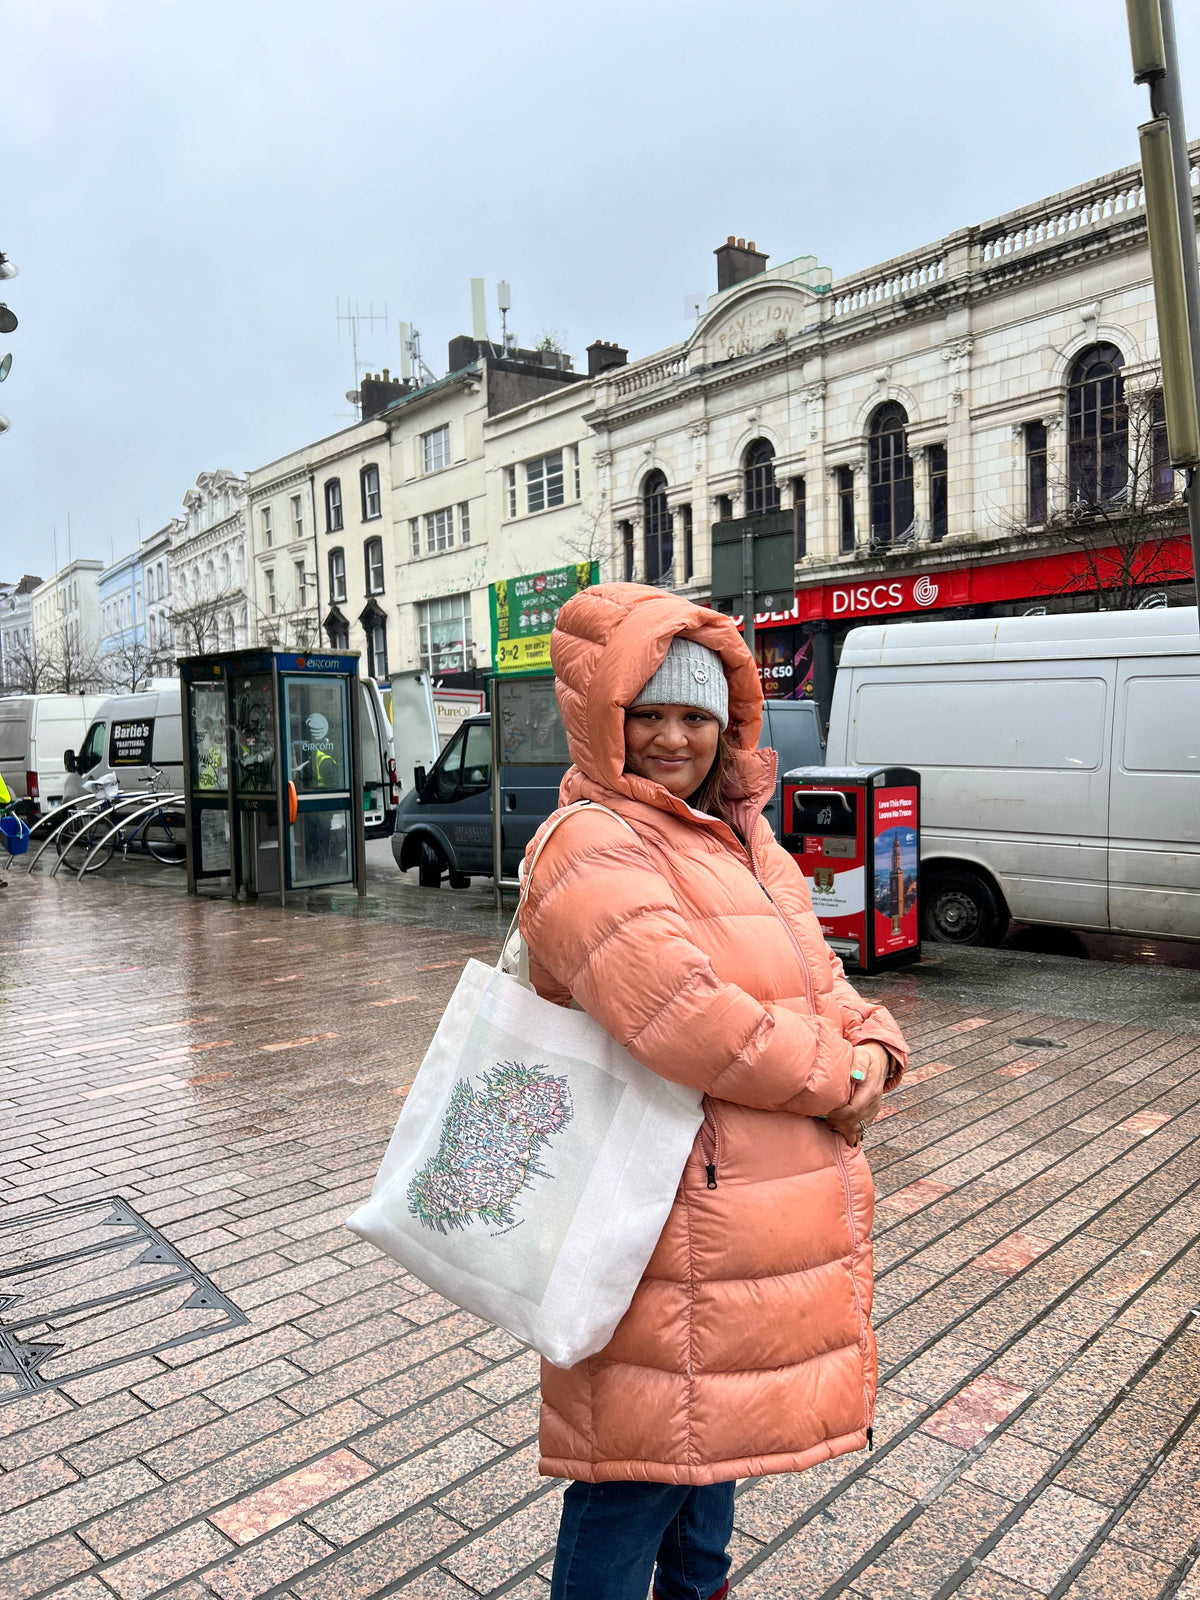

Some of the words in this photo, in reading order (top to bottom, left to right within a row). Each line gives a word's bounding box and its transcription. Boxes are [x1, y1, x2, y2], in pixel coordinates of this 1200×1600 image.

[832, 583, 903, 614] DISCS
[500, 646, 506, 662] 3
[512, 645, 519, 660] 2
[771, 664, 793, 679] €50
[114, 723, 150, 740] Bartie's
[898, 799, 912, 807] Place
[899, 809, 912, 817] Trace
